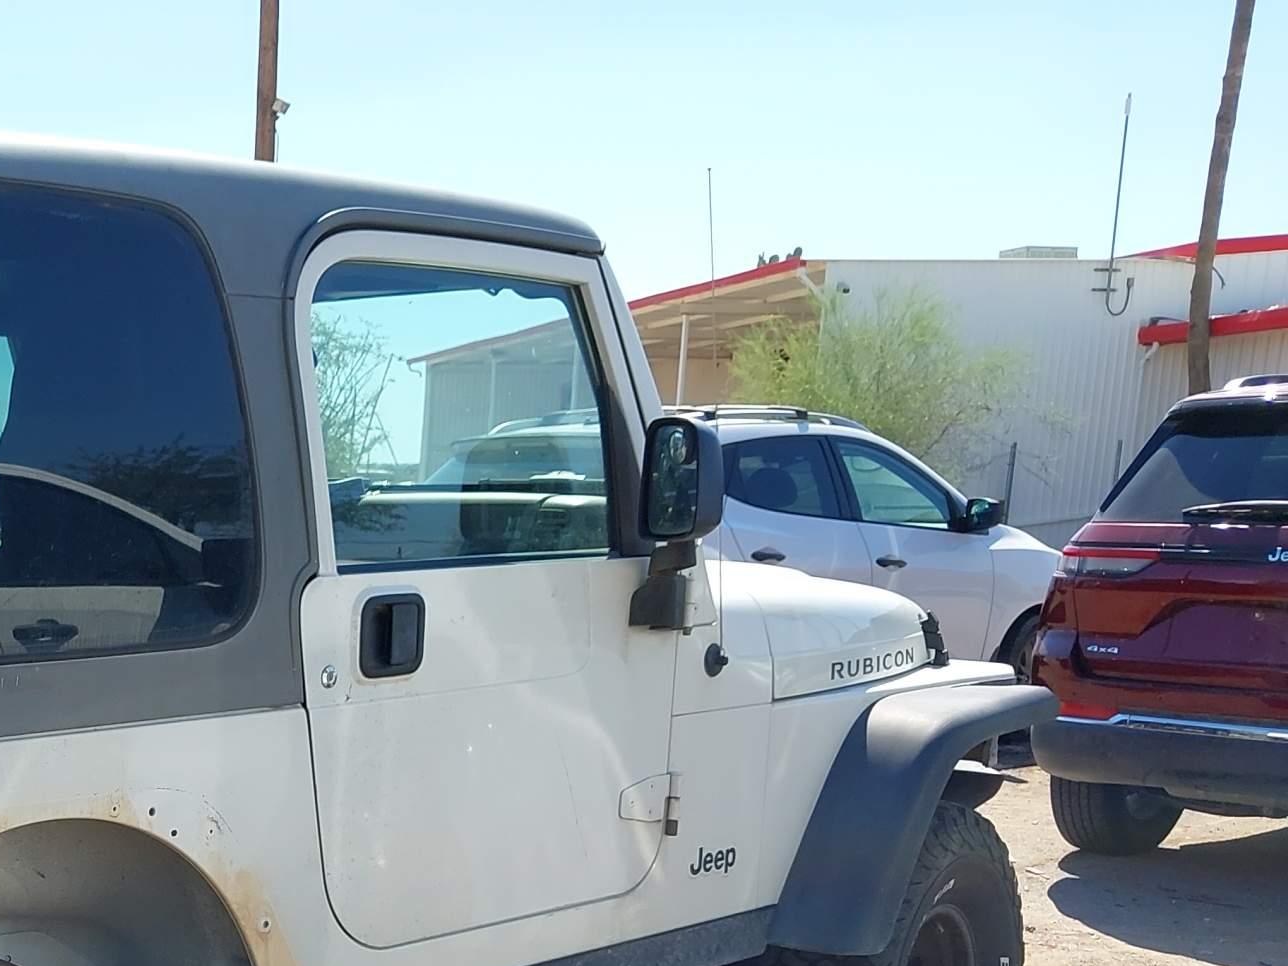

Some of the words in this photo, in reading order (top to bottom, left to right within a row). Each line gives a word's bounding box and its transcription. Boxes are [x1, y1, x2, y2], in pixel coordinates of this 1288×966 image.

[830, 647, 914, 680] RUBICON
[1086, 644, 1119, 655] 4x4
[690, 847, 736, 875] Jeep
